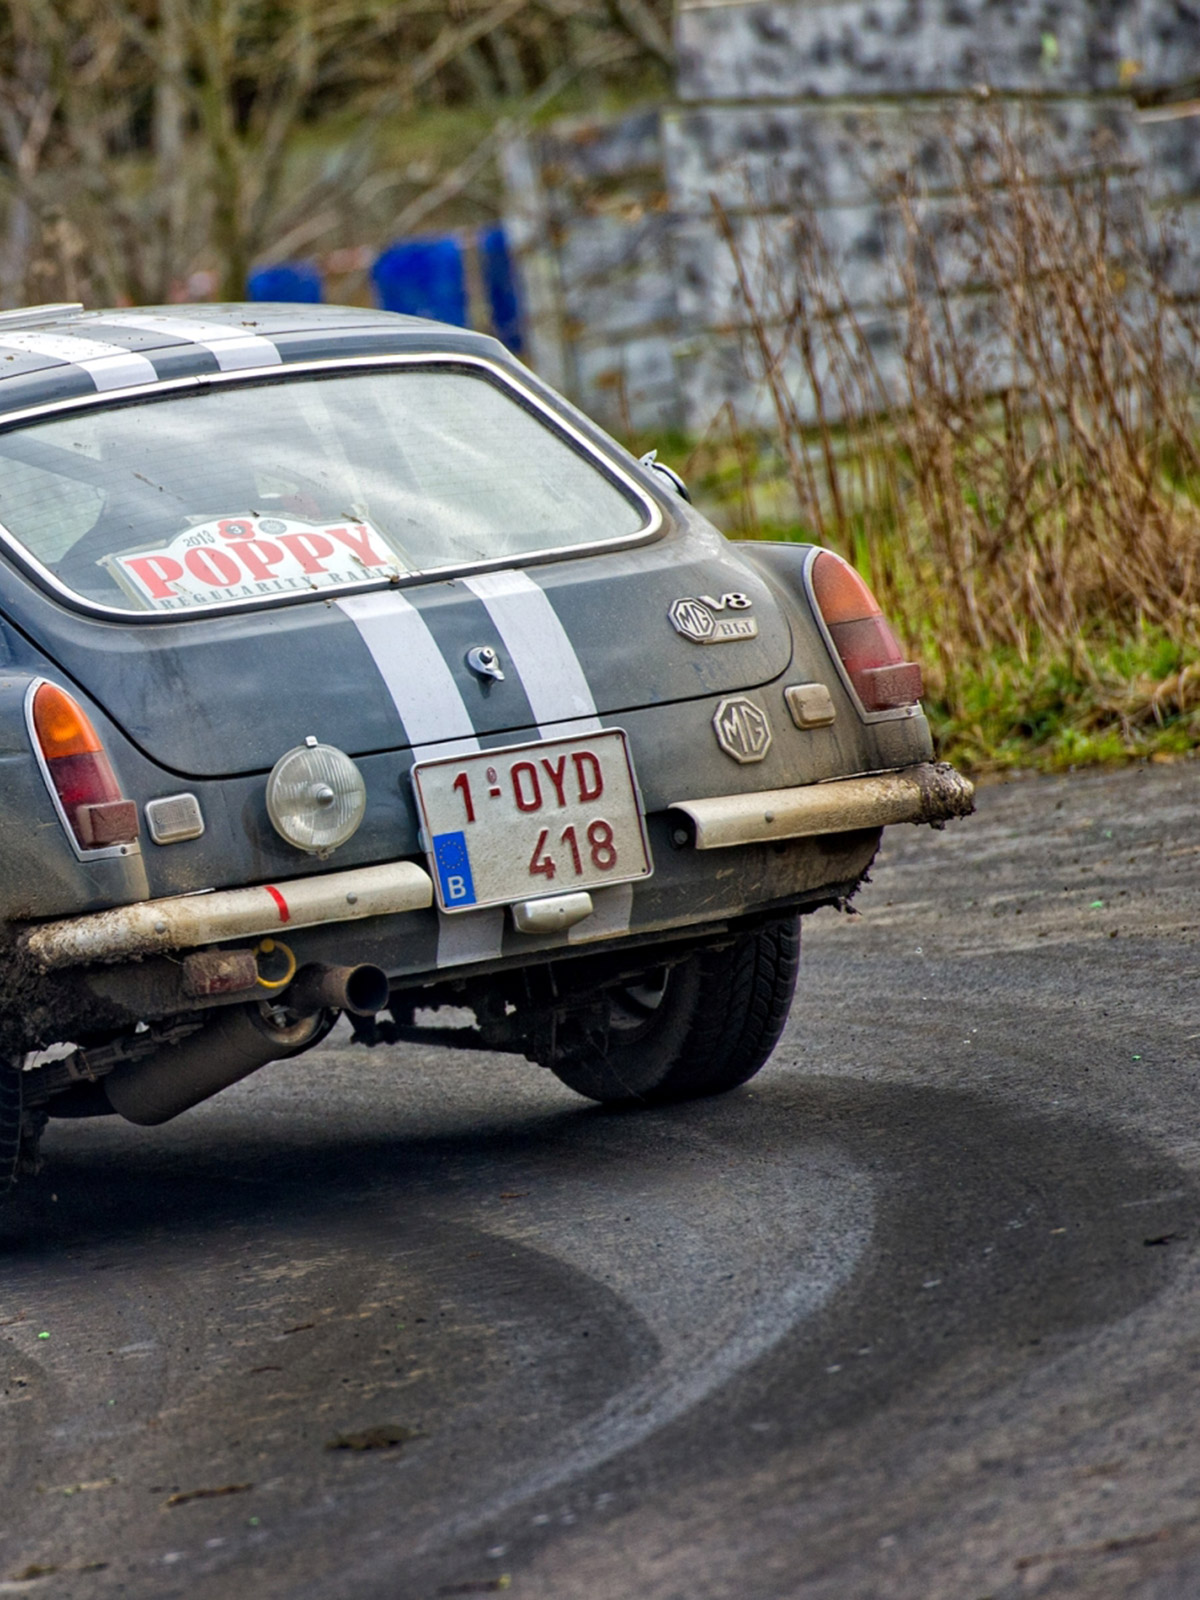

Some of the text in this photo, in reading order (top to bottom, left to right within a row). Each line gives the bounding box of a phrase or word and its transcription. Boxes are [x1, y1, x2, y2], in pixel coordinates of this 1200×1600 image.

[183, 530, 216, 547] 2013
[125, 526, 388, 600] POPPY
[159, 564, 401, 609] REGULARITY RALLY
[698, 592, 753, 611] V8
[673, 602, 712, 637] MG
[720, 703, 768, 755] MG
[529, 819, 618, 880] 418
[447, 875, 468, 900] B
